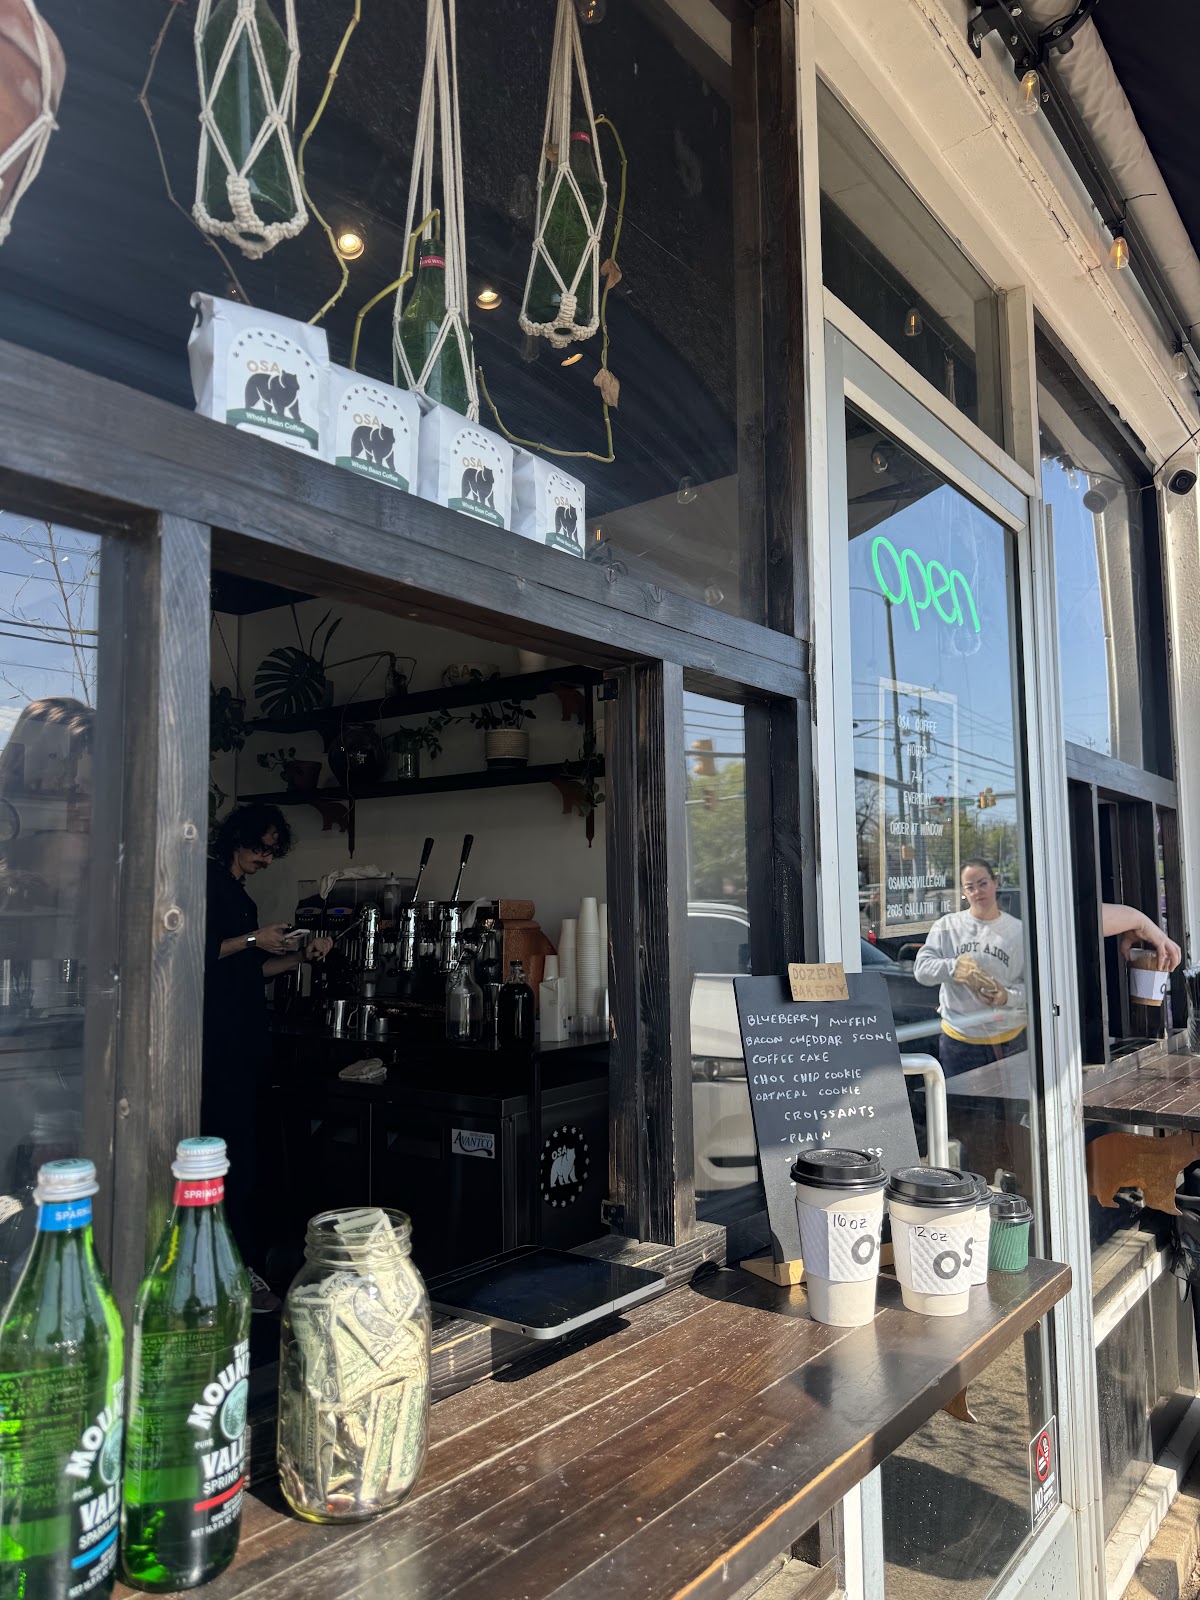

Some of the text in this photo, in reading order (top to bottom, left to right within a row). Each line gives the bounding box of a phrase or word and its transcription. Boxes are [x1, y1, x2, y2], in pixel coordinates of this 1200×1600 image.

[246, 360, 280, 373] OSA
[245, 411, 305, 434] Whole Bean Coffee
[352, 413, 380, 427] OSA
[462, 456, 483, 469] OSA
[351, 460, 399, 482] Whole Bean Coffee
[462, 501, 474, 511] Whole
[554, 496, 570, 507] OSA
[897, 715, 938, 734] OSA COFFEE
[907, 743, 928, 758] HOURS
[890, 821, 944, 836] ORDER AT WINDOW
[904, 901, 934, 916] GALLATIN
[792, 967, 839, 981] DOZEN
[792, 984, 847, 998] BAKERY
[747, 1014, 877, 1028] BLUEBERRY MUFFIN
[745, 1032, 892, 1047] BACON CHEDDAR SCONE
[752, 1052, 830, 1064] COFFEE CAKE
[753, 1069, 862, 1085] CHOC CHIP COOKIE
[755, 1085, 861, 1101] OATMEAL COOKIE
[784, 1105, 875, 1121] CROISSANTS
[551, 1145, 567, 1161] OSA
[183, 1187, 217, 1199] SPRING
[833, 1213, 846, 1228] 16
[914, 1226, 927, 1238] 12
[193, 1438, 214, 1450] PURE
[203, 1467, 240, 1495] SPRING
[1034, 1486, 1044, 1515] NO
